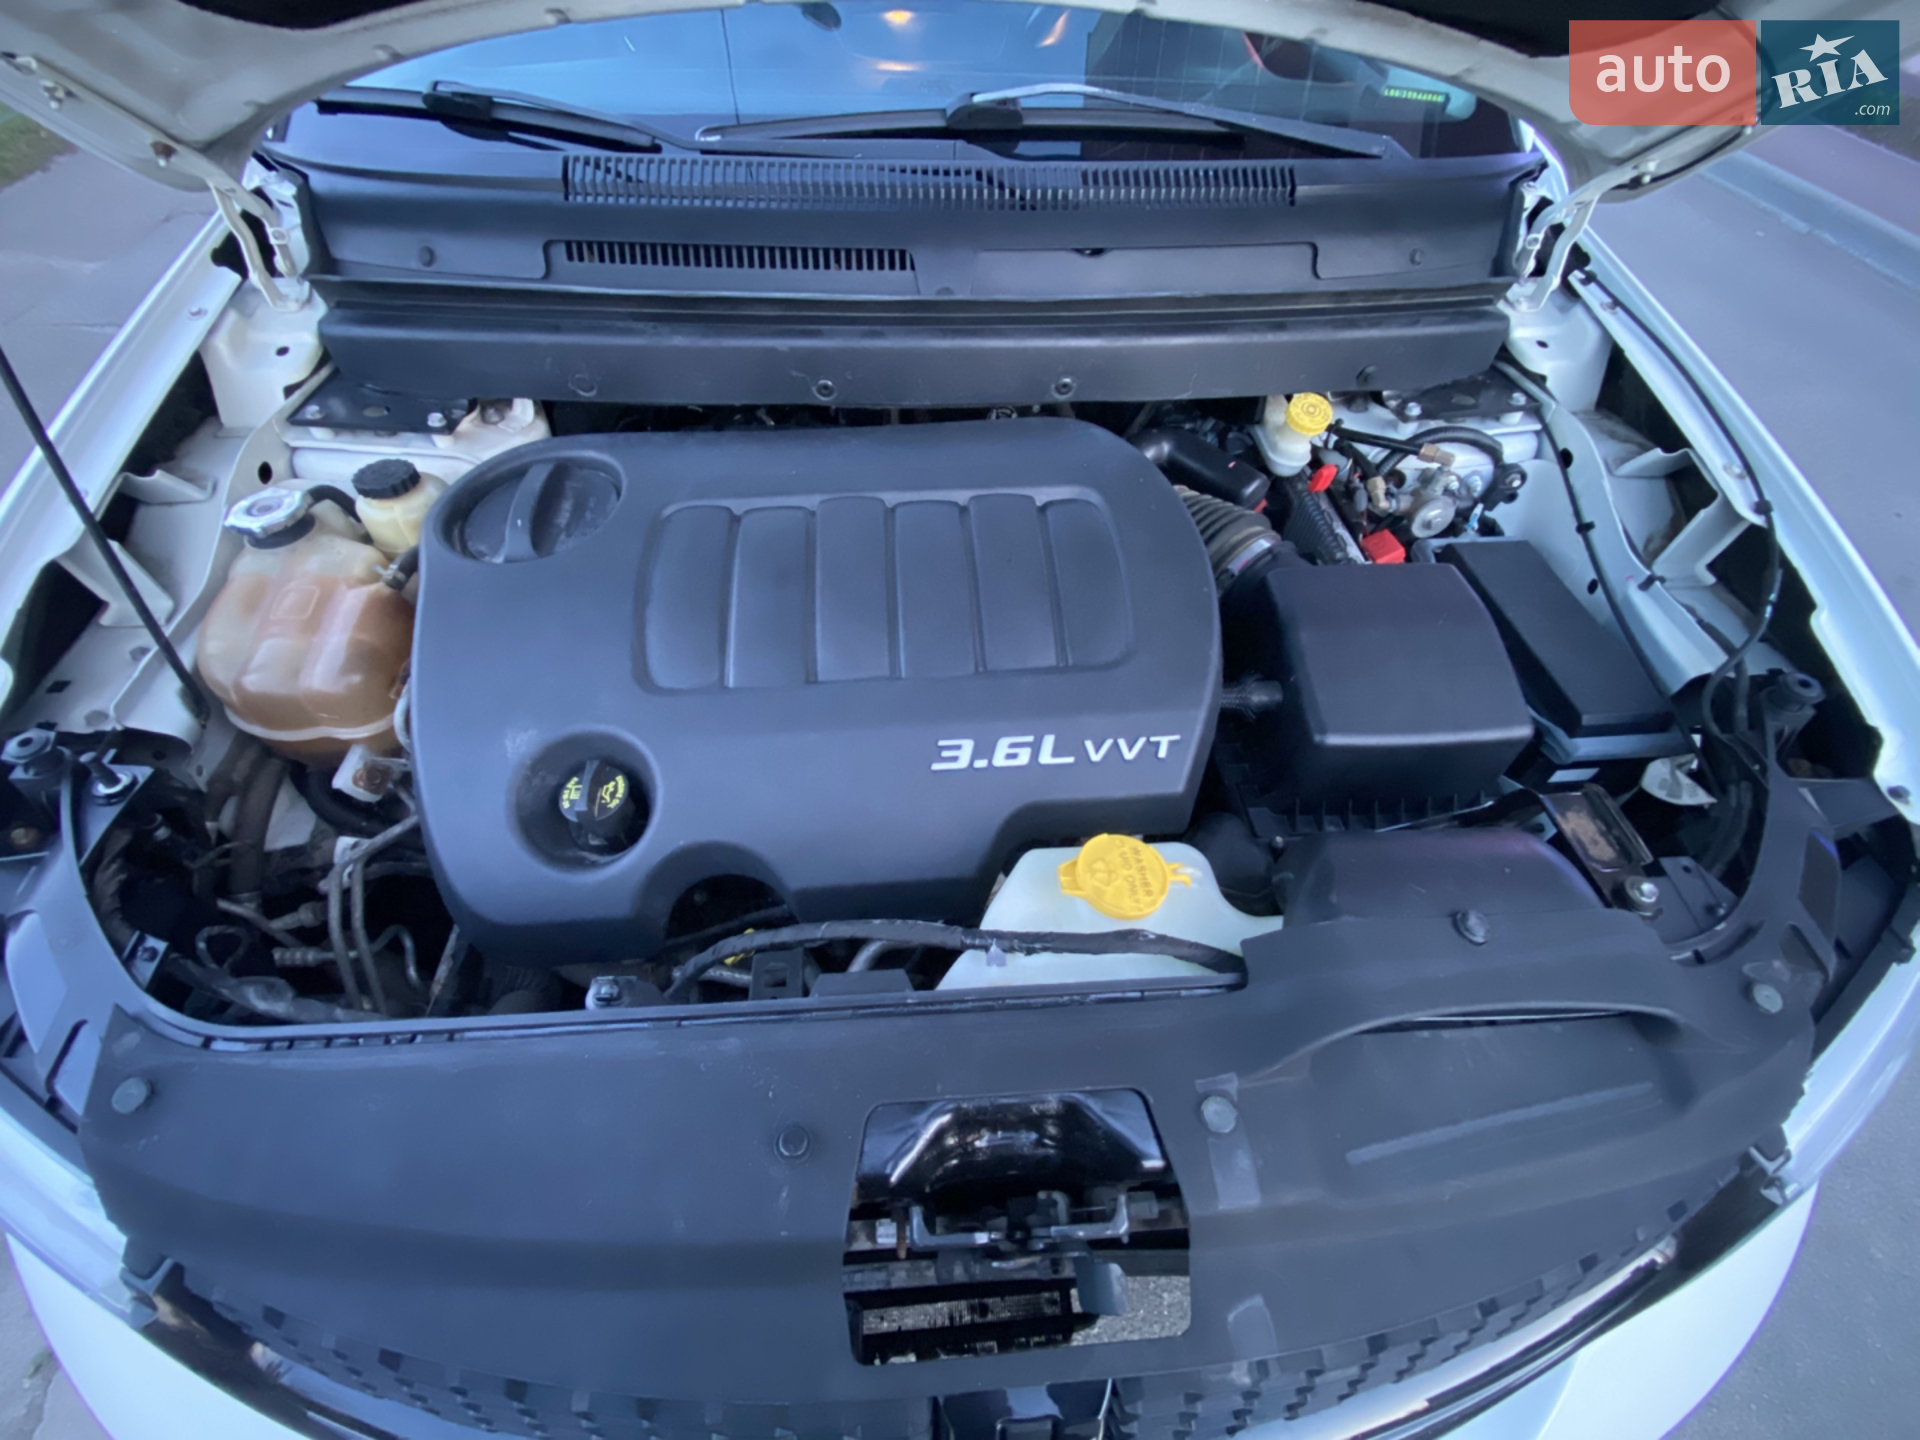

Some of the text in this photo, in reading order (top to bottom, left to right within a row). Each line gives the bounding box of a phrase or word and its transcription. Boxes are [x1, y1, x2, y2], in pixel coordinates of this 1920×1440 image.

[930, 734, 1182, 771] 3.6L VVT
[1130, 846, 1155, 898] WASHER
